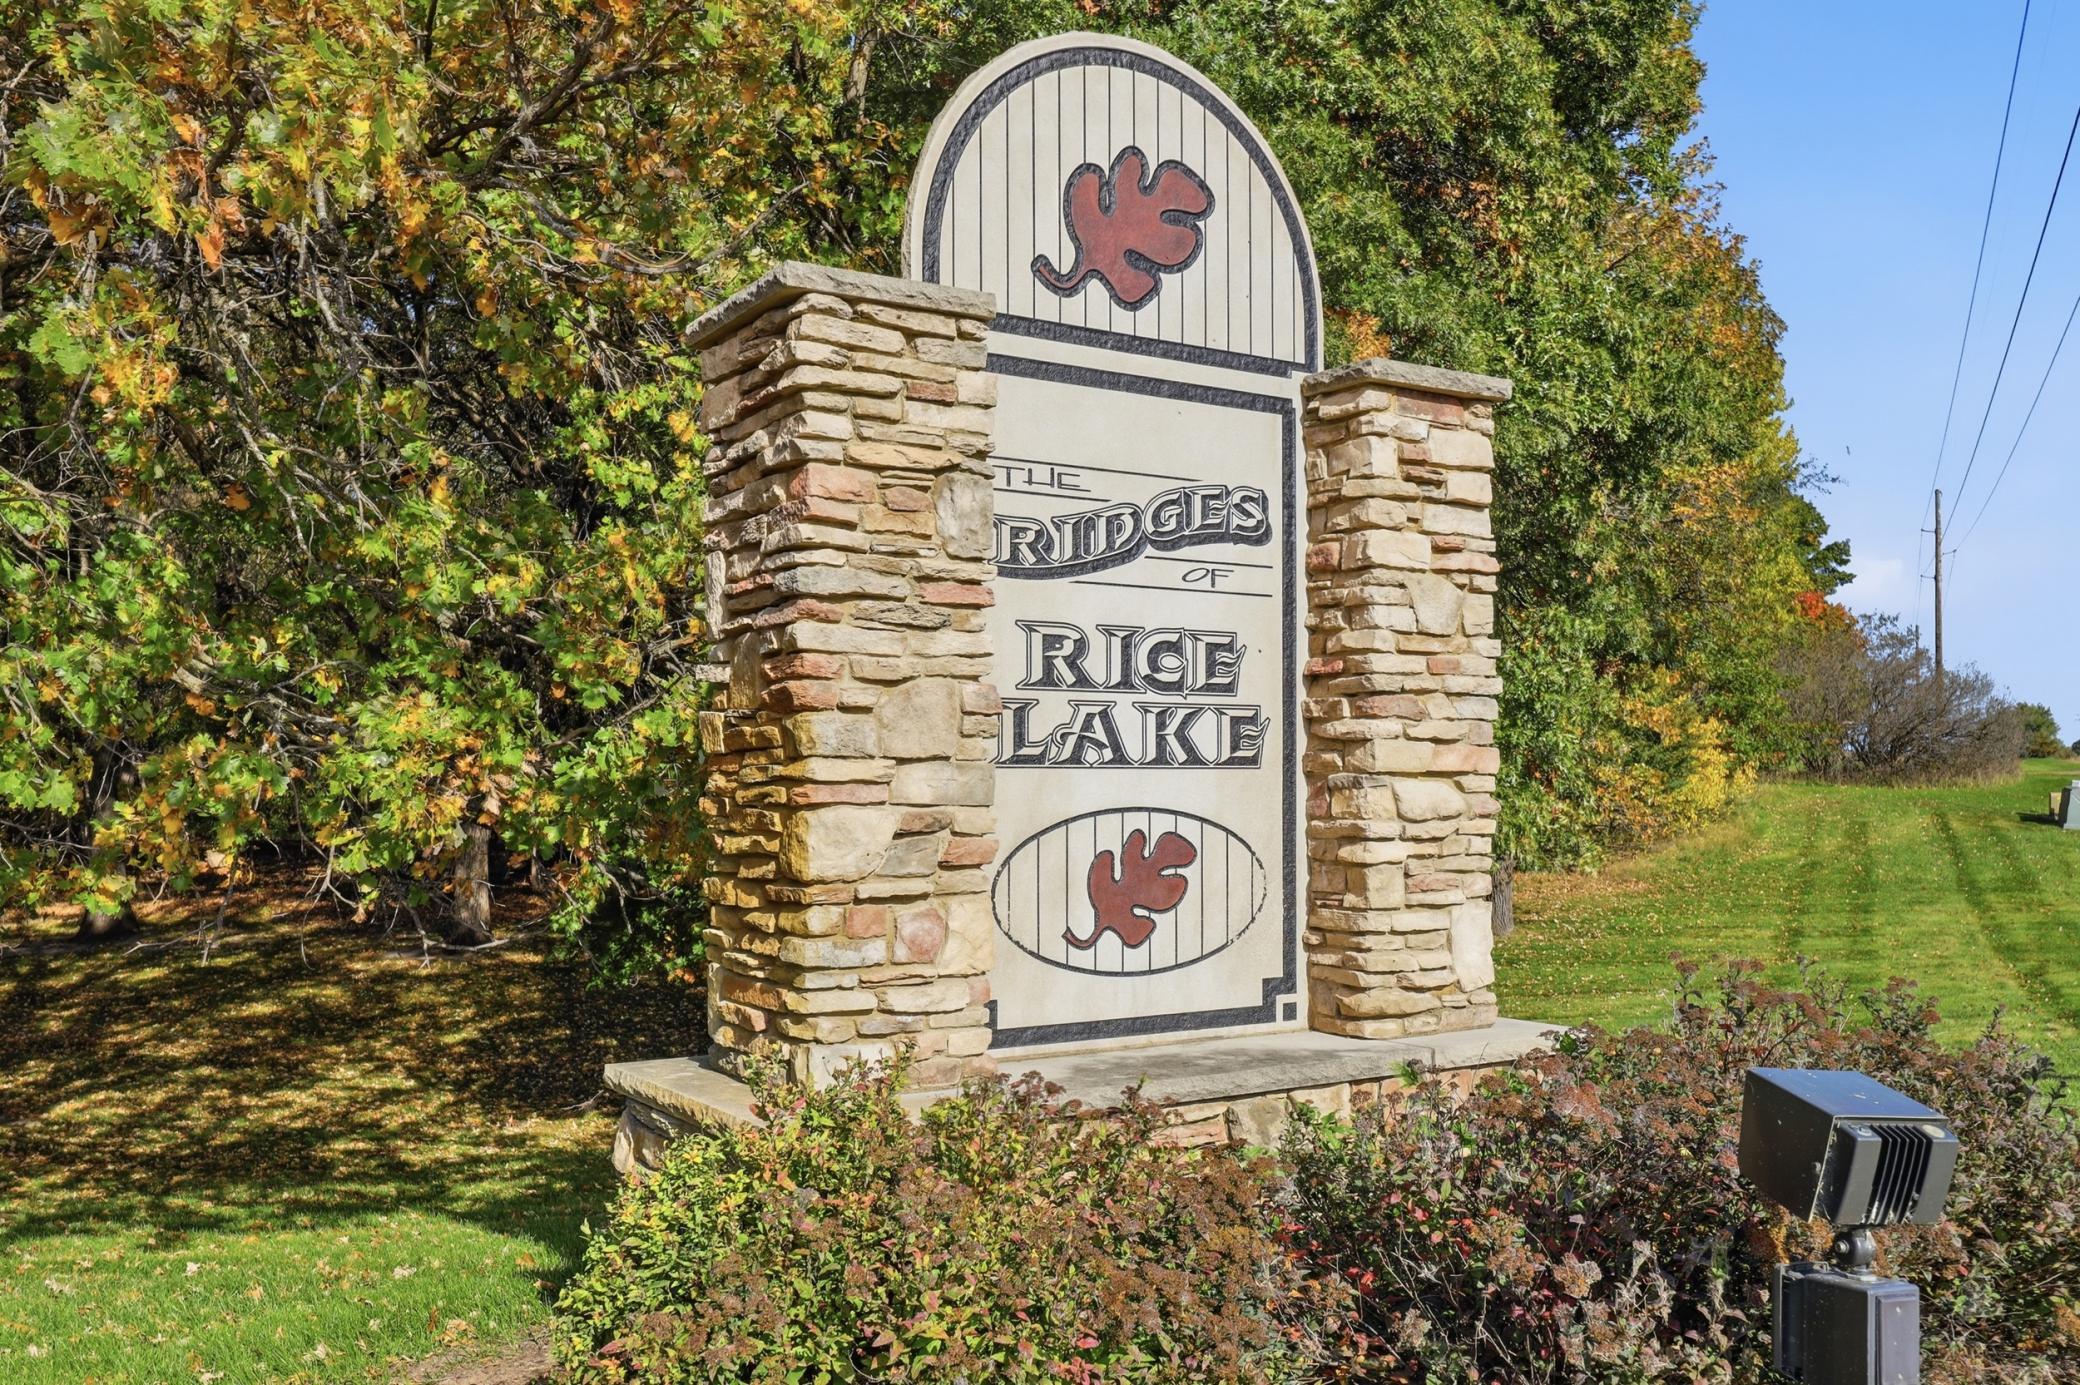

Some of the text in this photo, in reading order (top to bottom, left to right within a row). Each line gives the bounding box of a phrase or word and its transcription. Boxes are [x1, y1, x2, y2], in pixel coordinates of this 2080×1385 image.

[993, 465, 1091, 492] THE
[993, 485, 1272, 580] RIDGES
[1181, 567, 1235, 589] OF
[1015, 619, 1248, 700] RICE
[993, 697, 1271, 770] LAKE
